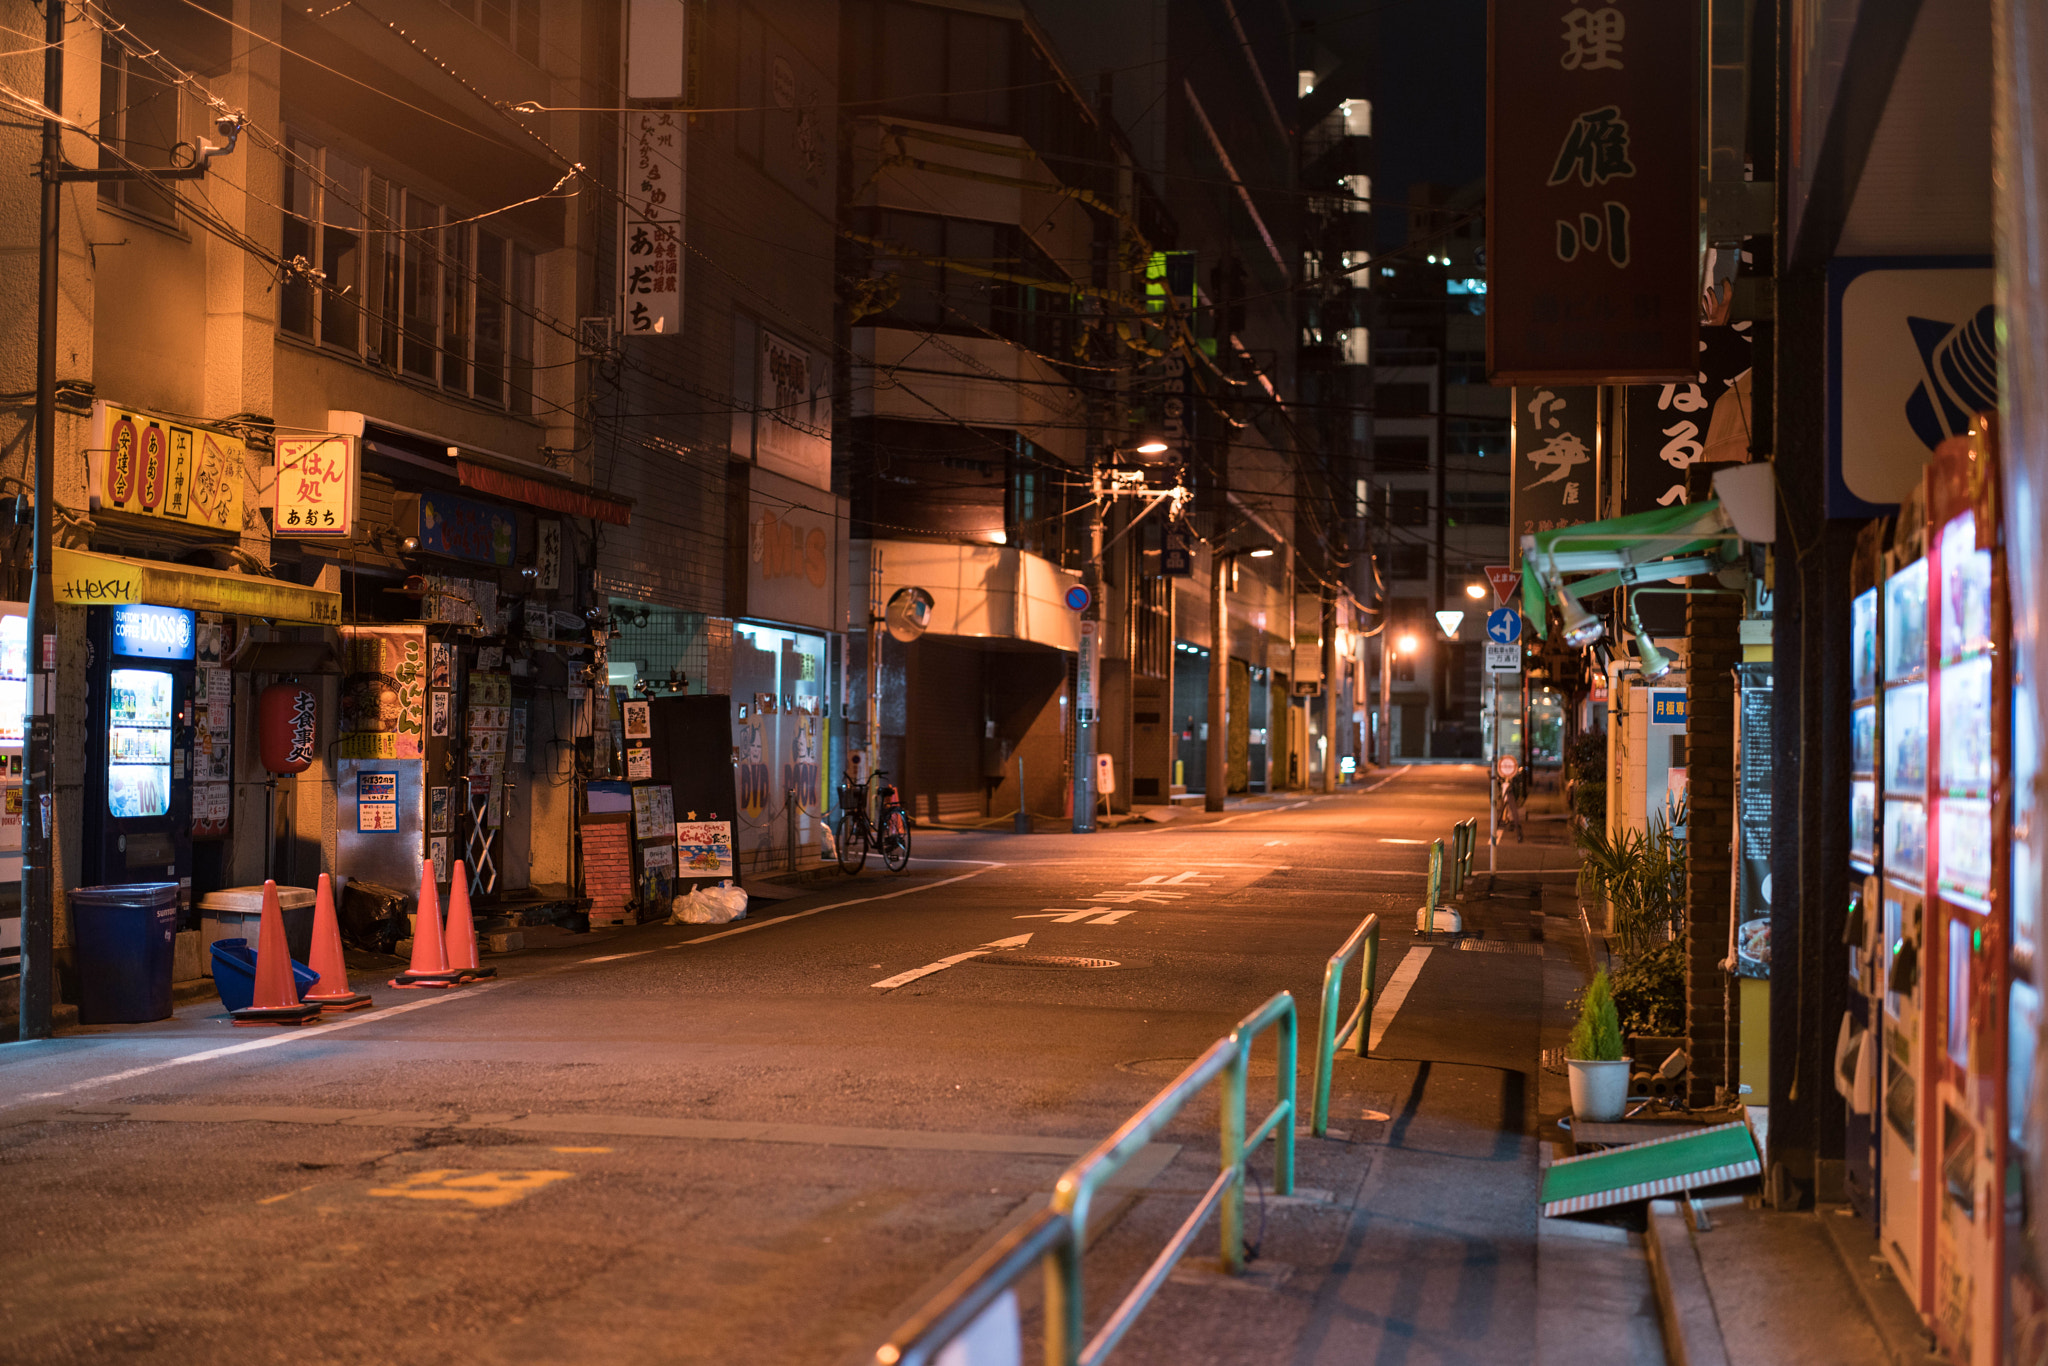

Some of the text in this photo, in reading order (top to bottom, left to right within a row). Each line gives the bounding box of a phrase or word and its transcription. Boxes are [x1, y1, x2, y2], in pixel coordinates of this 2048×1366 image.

[1560, 0, 1626, 71] 理
[639, 114, 656, 170] じゃんがら
[657, 112, 674, 148] 九州
[1546, 105, 1637, 269] 雁川
[629, 226, 654, 332] あだち
[653, 229, 666, 293] 田舎料理
[115, 427, 131, 497] 安達会
[283, 445, 344, 484] ごはん
[296, 478, 323, 504] 処
[1493, 573, 1517, 583] 止まれ
[115, 624, 141, 638] COFFEE
[141, 613, 176, 644] BOSS
[1488, 655, 1519, 663] 一方通行
[286, 691, 317, 764] お食事処
[1656, 701, 1685, 715] 月極専
[138, 781, 157, 813] 100
[740, 763, 770, 810] DVD
